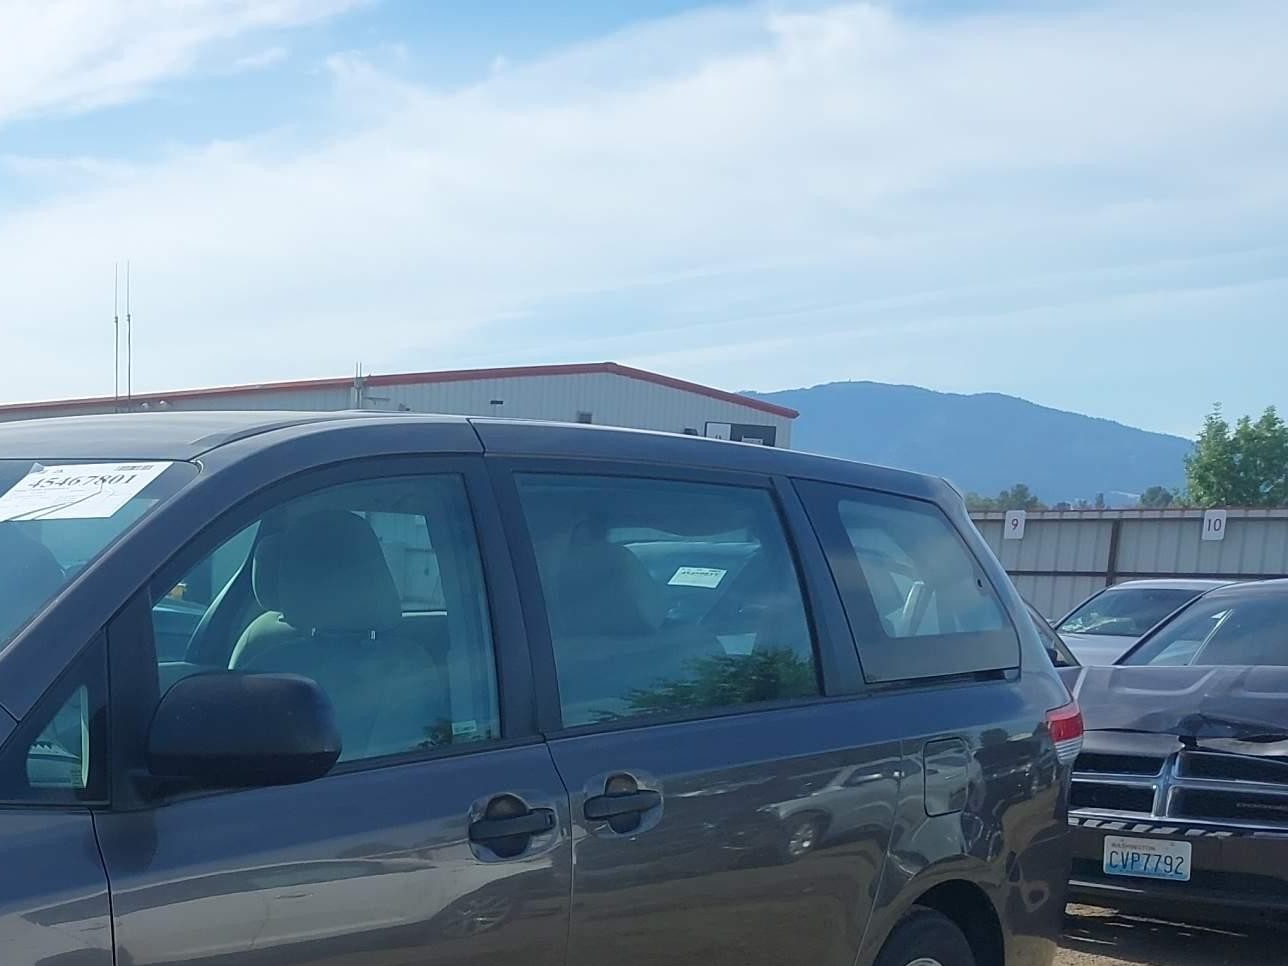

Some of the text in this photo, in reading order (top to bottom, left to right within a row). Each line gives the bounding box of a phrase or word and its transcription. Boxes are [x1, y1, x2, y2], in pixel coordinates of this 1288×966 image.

[28, 473, 139, 489] 45467801
[1010, 518, 1019, 531] 9
[1206, 518, 1222, 532] 10
[1108, 850, 1185, 875] CVP7792
